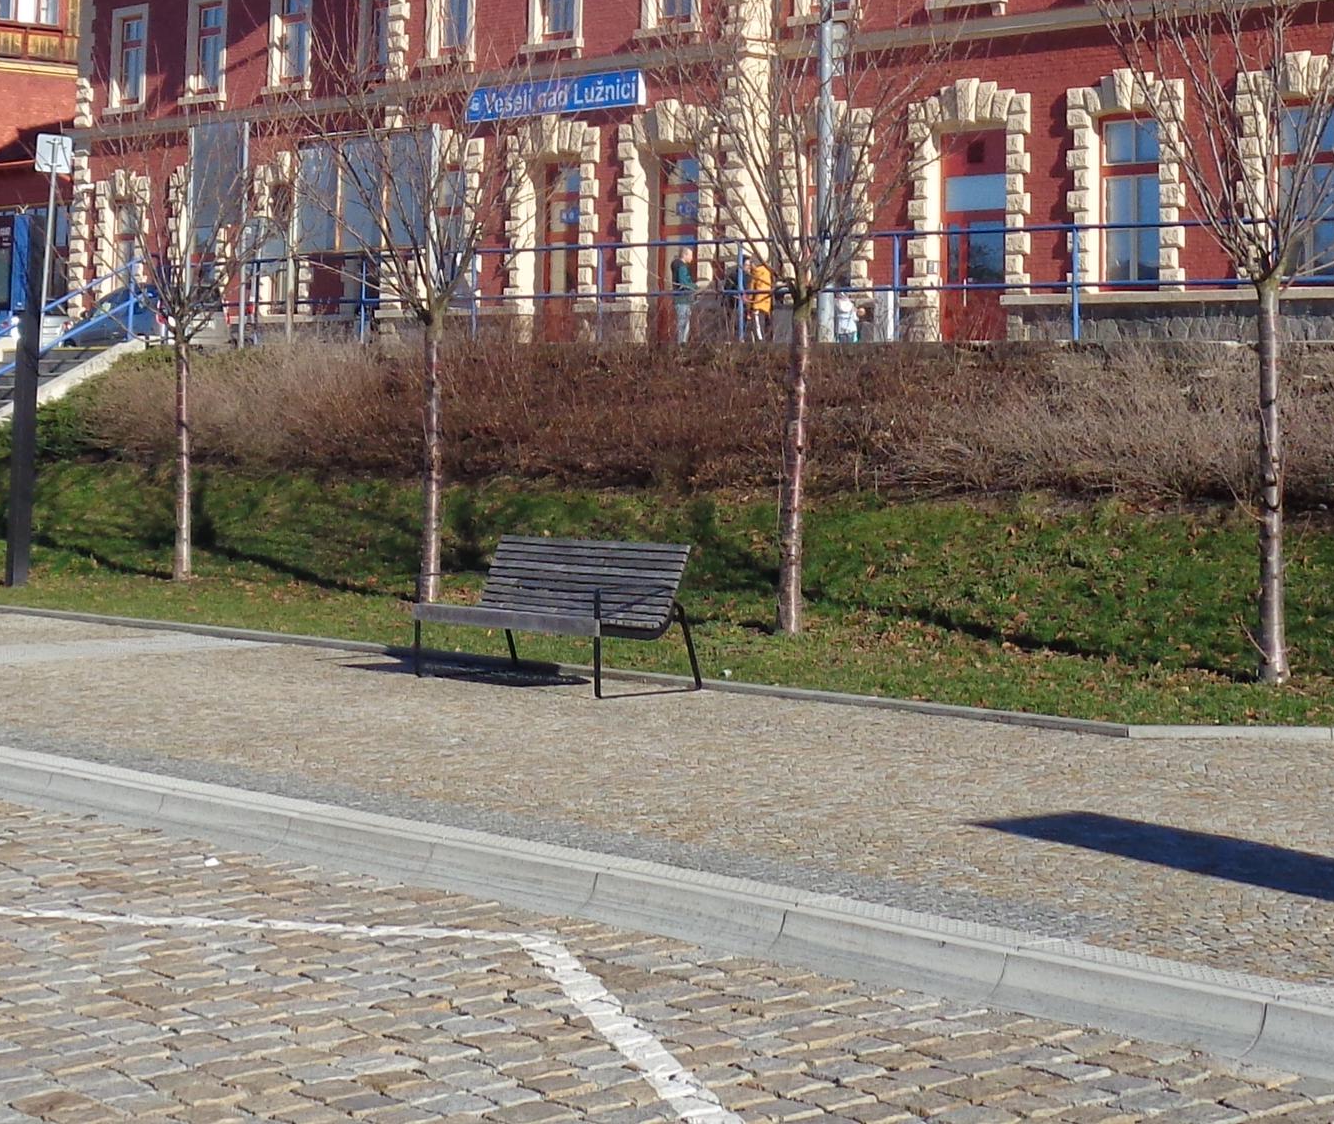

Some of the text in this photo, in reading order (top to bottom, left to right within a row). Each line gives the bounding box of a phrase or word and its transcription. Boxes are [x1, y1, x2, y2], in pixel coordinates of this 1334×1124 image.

[484, 76, 636, 115] Veselí nad Lužnicí
